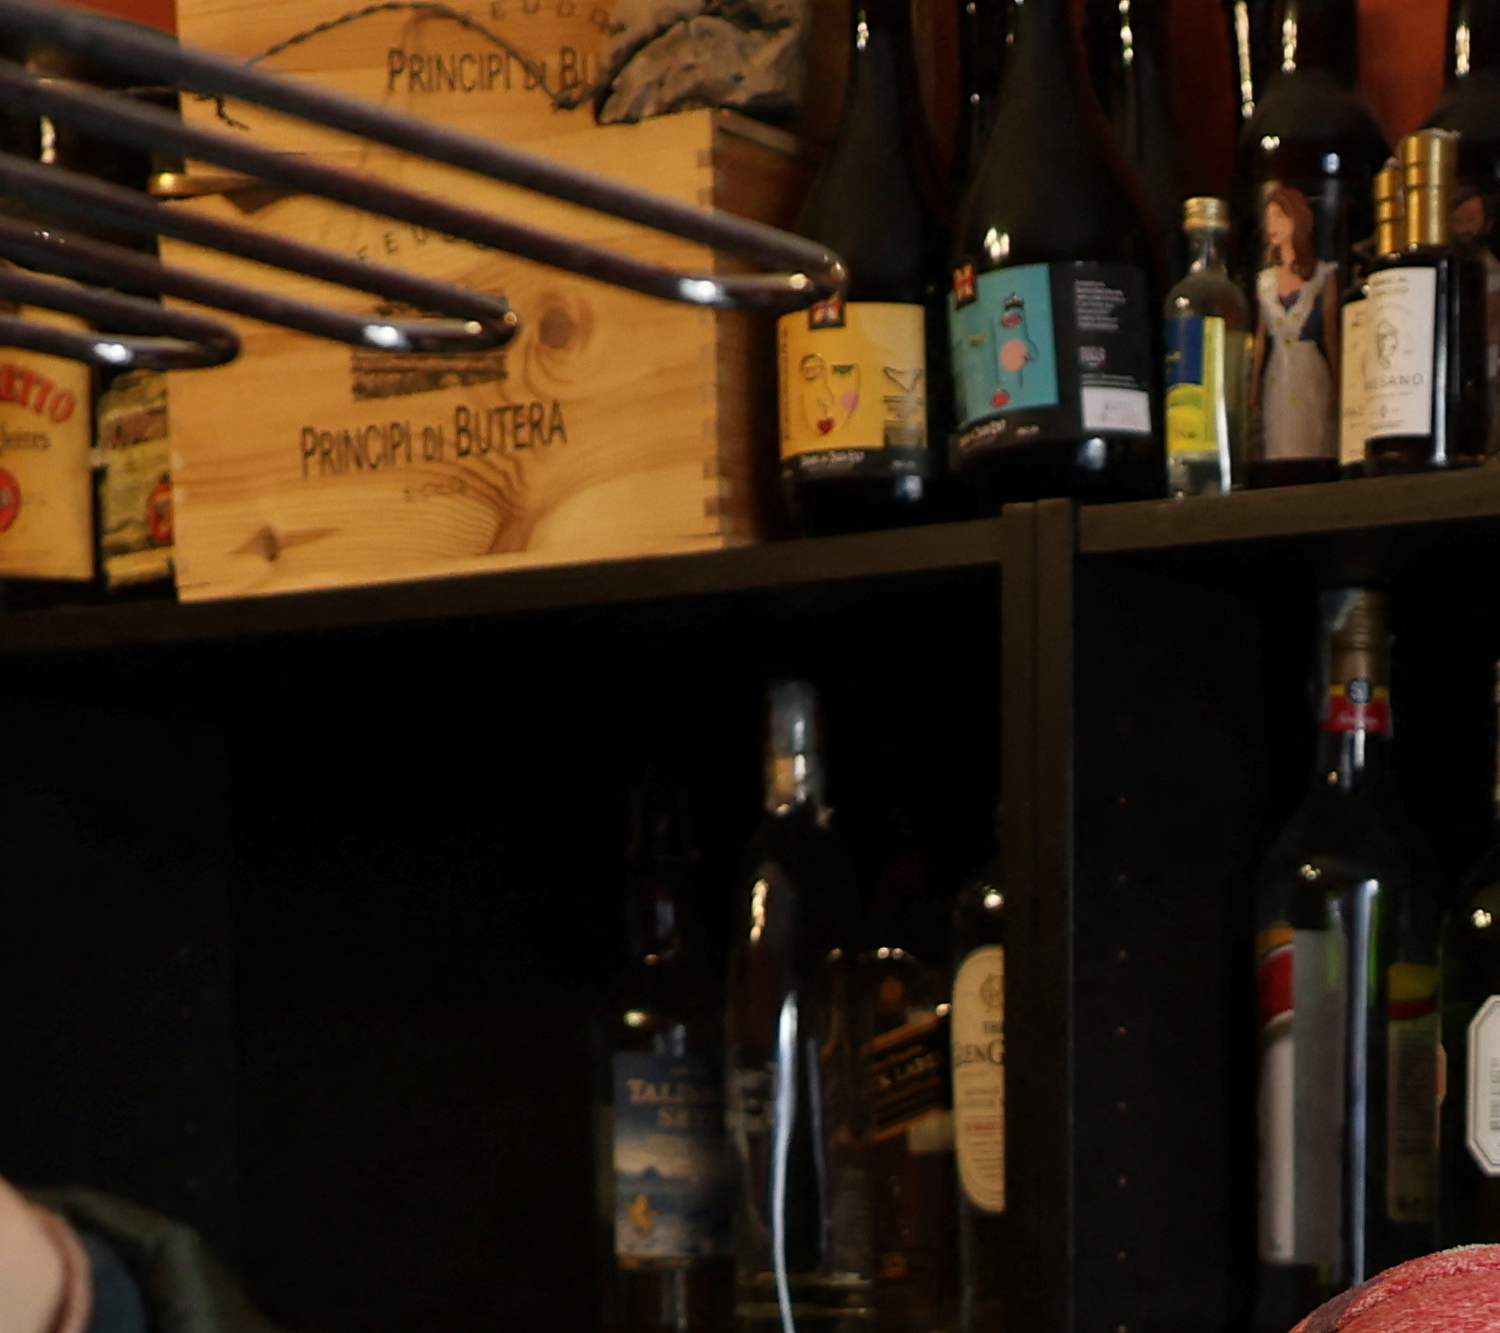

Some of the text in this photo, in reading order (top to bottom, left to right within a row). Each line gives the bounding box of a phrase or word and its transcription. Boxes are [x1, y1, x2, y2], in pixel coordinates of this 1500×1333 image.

[387, 47, 511, 94] PRINCIPI
[301, 399, 568, 479] PRINCIPI DI BUTERA
